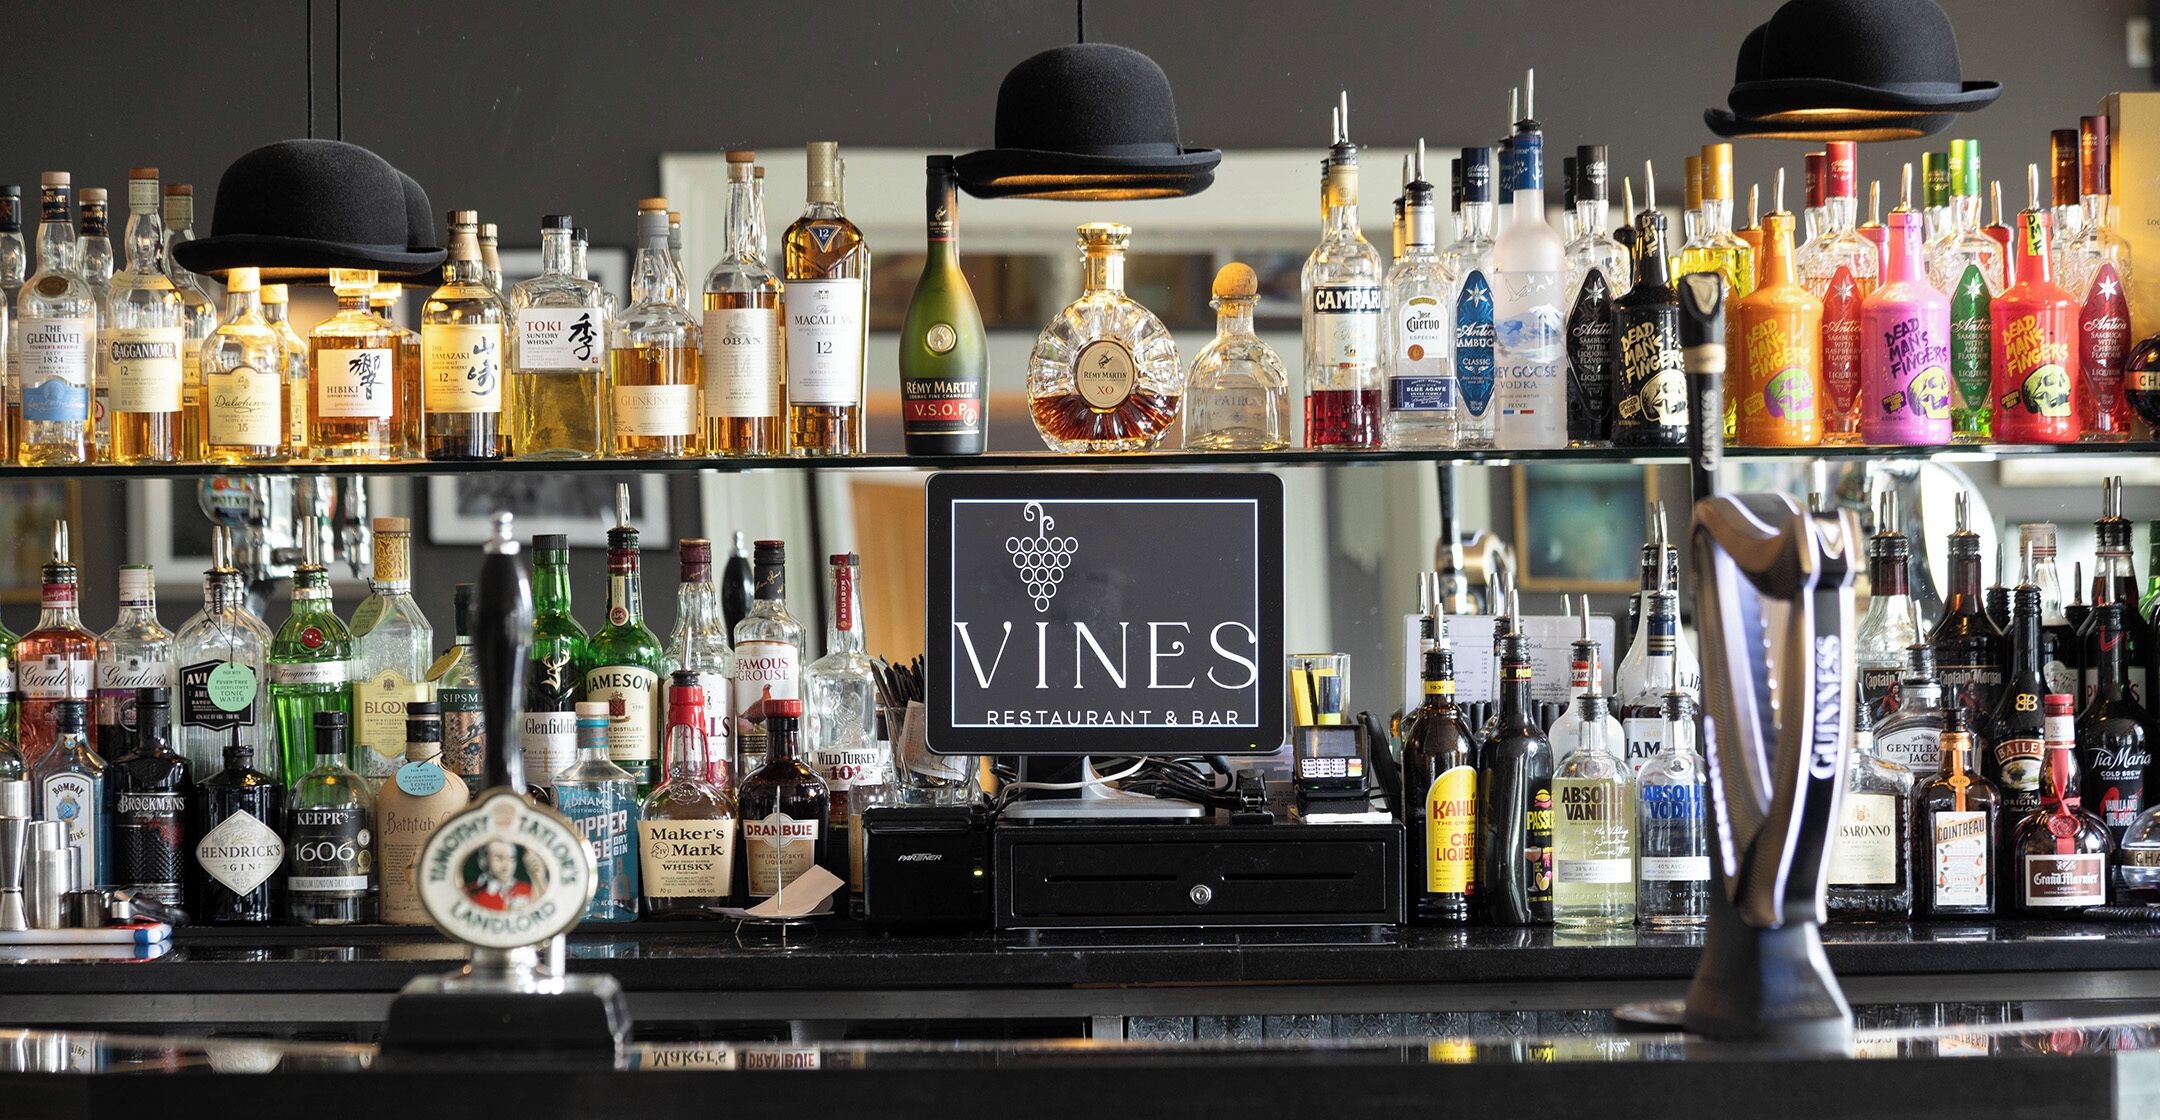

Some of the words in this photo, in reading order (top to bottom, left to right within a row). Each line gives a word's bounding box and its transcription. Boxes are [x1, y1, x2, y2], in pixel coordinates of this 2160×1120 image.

[819, 229, 829, 238] 12
[1316, 289, 1381, 311] CAMPARI
[1417, 310, 1431, 320] Jose
[45, 325, 62, 333] THE
[526, 320, 562, 331] TOKI
[1406, 316, 1440, 332] Cuervo
[2002, 314, 2036, 346] DEAD
[2083, 314, 2127, 332] Antica
[27, 333, 79, 344] GLENLIVET
[568, 312, 598, 361] 季
[1620, 322, 1655, 352] DEAD
[1745, 318, 1778, 347] DEAD
[1884, 318, 1920, 348] DEAD
[722, 336, 762, 346] OBAN
[817, 341, 833, 354] 12
[1887, 331, 1929, 362] MAN'S
[2005, 326, 2045, 361] MAN'S
[111, 341, 176, 364] CRAGGANMORE
[431, 352, 470, 360] YAMAZAKI
[1624, 334, 1664, 367] MAN'S
[1463, 358, 1491, 366] CLASSIC
[1751, 347, 1811, 381] FINGERS
[1890, 346, 1948, 379] FINGERS
[2007, 343, 2069, 377] FINGERS
[120, 366, 129, 376] 12
[439, 372, 449, 382] 12
[1102, 371, 1127, 379] MARTIN
[1512, 366, 1556, 378] GOOSE
[326, 385, 359, 394] HIBIKI
[906, 381, 932, 394] RÉMY
[934, 380, 978, 394] MARTIN
[1097, 385, 1114, 395] XO
[1500, 381, 1537, 389] VODKA
[237, 423, 249, 433] 15
[953, 621, 1258, 690] VINES
[739, 658, 789, 670] FAMOUS
[103, 662, 168, 688] Gordon's
[739, 670, 790, 681] GROUSE
[1865, 670, 1895, 691] Captain
[1940, 670, 1971, 688] Captain
[587, 673, 652, 695] JAMESON
[1809, 634, 1840, 780] GUINNESS
[986, 710, 1152, 726] RESTAURANT
[1165, 710, 1178, 726] &
[1192, 710, 1240, 726] BAR
[1887, 743, 1940, 753] GENTLEM
[817, 751, 840, 765] WILD
[841, 751, 877, 765] TURKEY
[1909, 753, 1937, 763] JACK
[2088, 748, 2114, 769] Tia
[2110, 747, 2152, 769] Maria
[2100, 770, 2121, 778] COLD
[52, 783, 85, 797] BOMBAY
[118, 795, 185, 813] BROCKMANS
[564, 795, 613, 810] ADNAMS
[1433, 794, 1477, 819] KAHLÚ
[1650, 801, 1705, 819] VODKA
[384, 811, 436, 835] Bathtub
[574, 809, 628, 839] OPPER
[1937, 817, 1985, 843] COINTREAU
[650, 827, 725, 841] Maker's
[747, 824, 813, 837] DRAMBUIE
[1840, 825, 1891, 838] ISARONNO
[613, 833, 628, 846] DRY
[1450, 833, 1476, 847] COFF
[201, 845, 281, 858] HENDRICK'S
[295, 841, 356, 862] 1606
[429, 815, 490, 882] TIMOTHY
[518, 816, 577, 886] TAYLOR'S
[613, 844, 628, 857] GIN
[671, 843, 724, 857] Mark
[1436, 847, 1477, 861] LIQUEU
[229, 863, 256, 872] GIN
[662, 863, 714, 871] WHISKY
[2033, 872, 2061, 886] Grand
[2061, 872, 2099, 886] Marnier
[451, 900, 557, 934] LANDLORD
